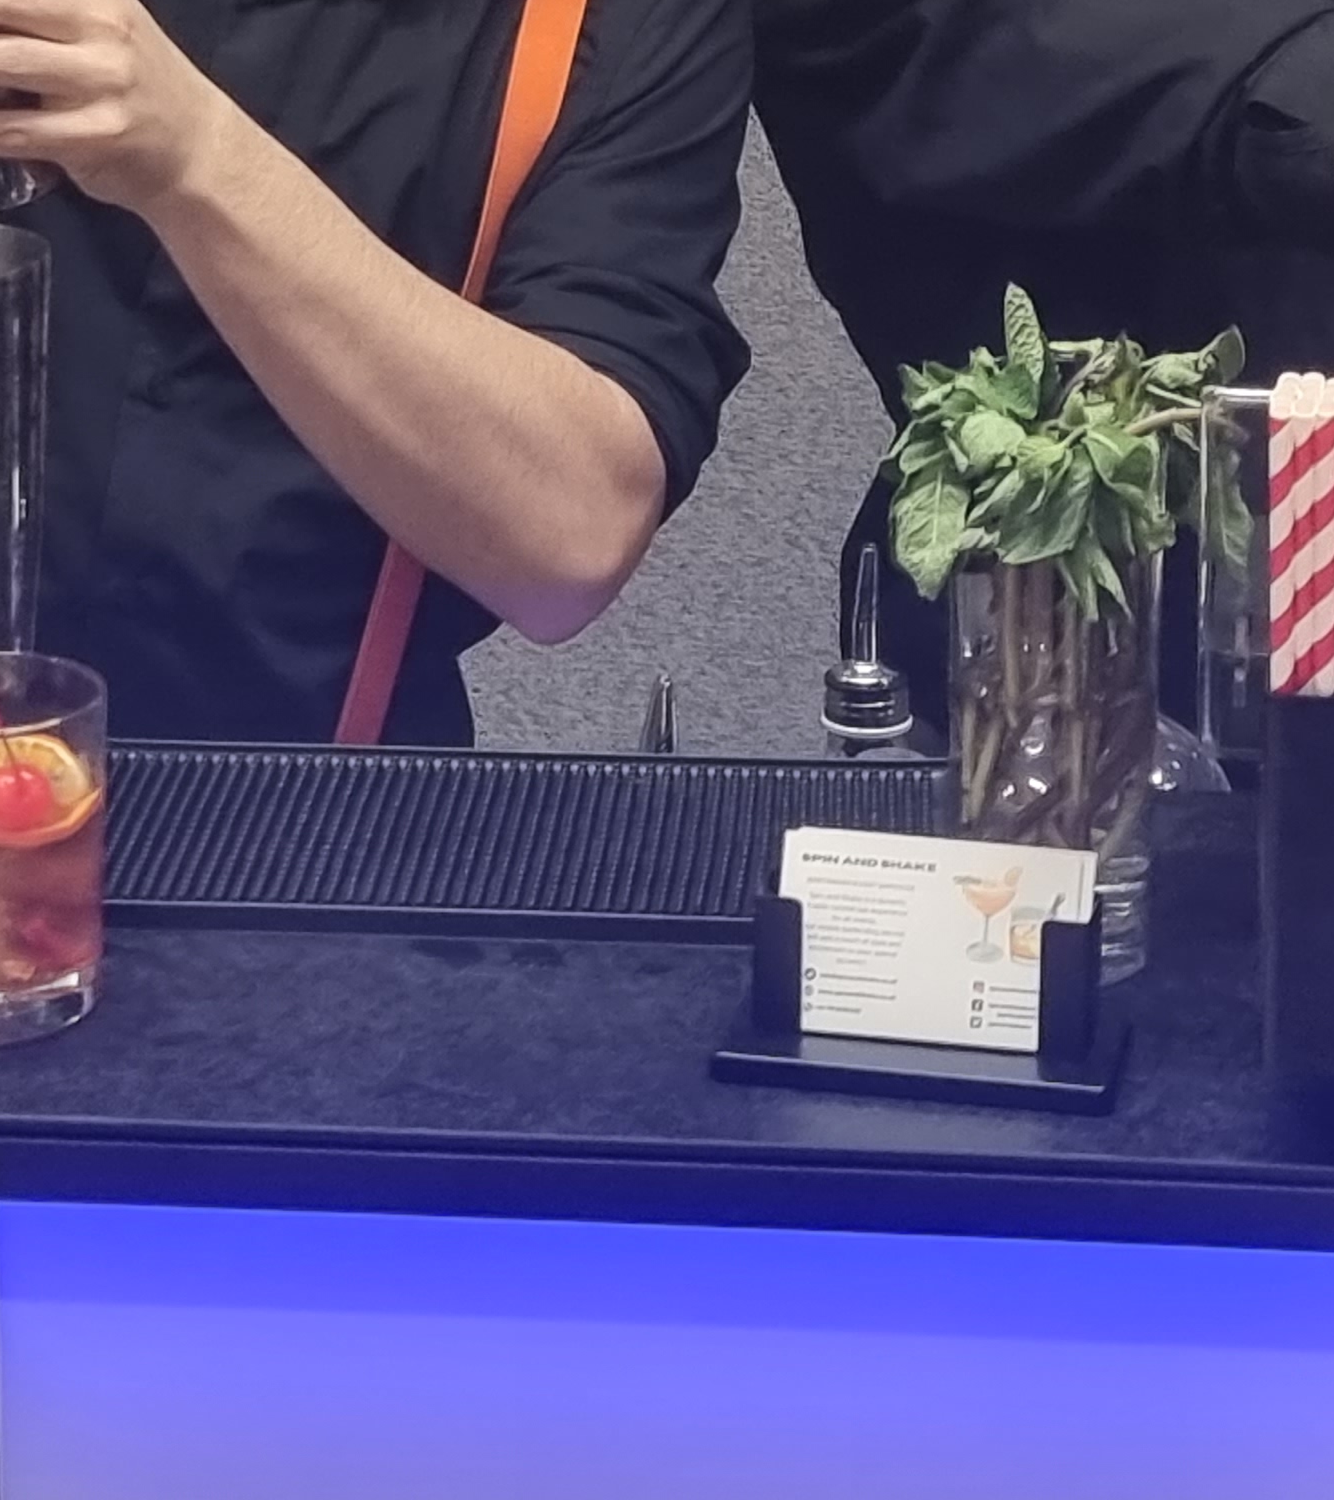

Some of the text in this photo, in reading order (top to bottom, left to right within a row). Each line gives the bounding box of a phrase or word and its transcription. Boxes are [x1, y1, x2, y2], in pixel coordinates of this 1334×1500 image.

[801, 852, 937, 873] SPIN AND SHAKE
